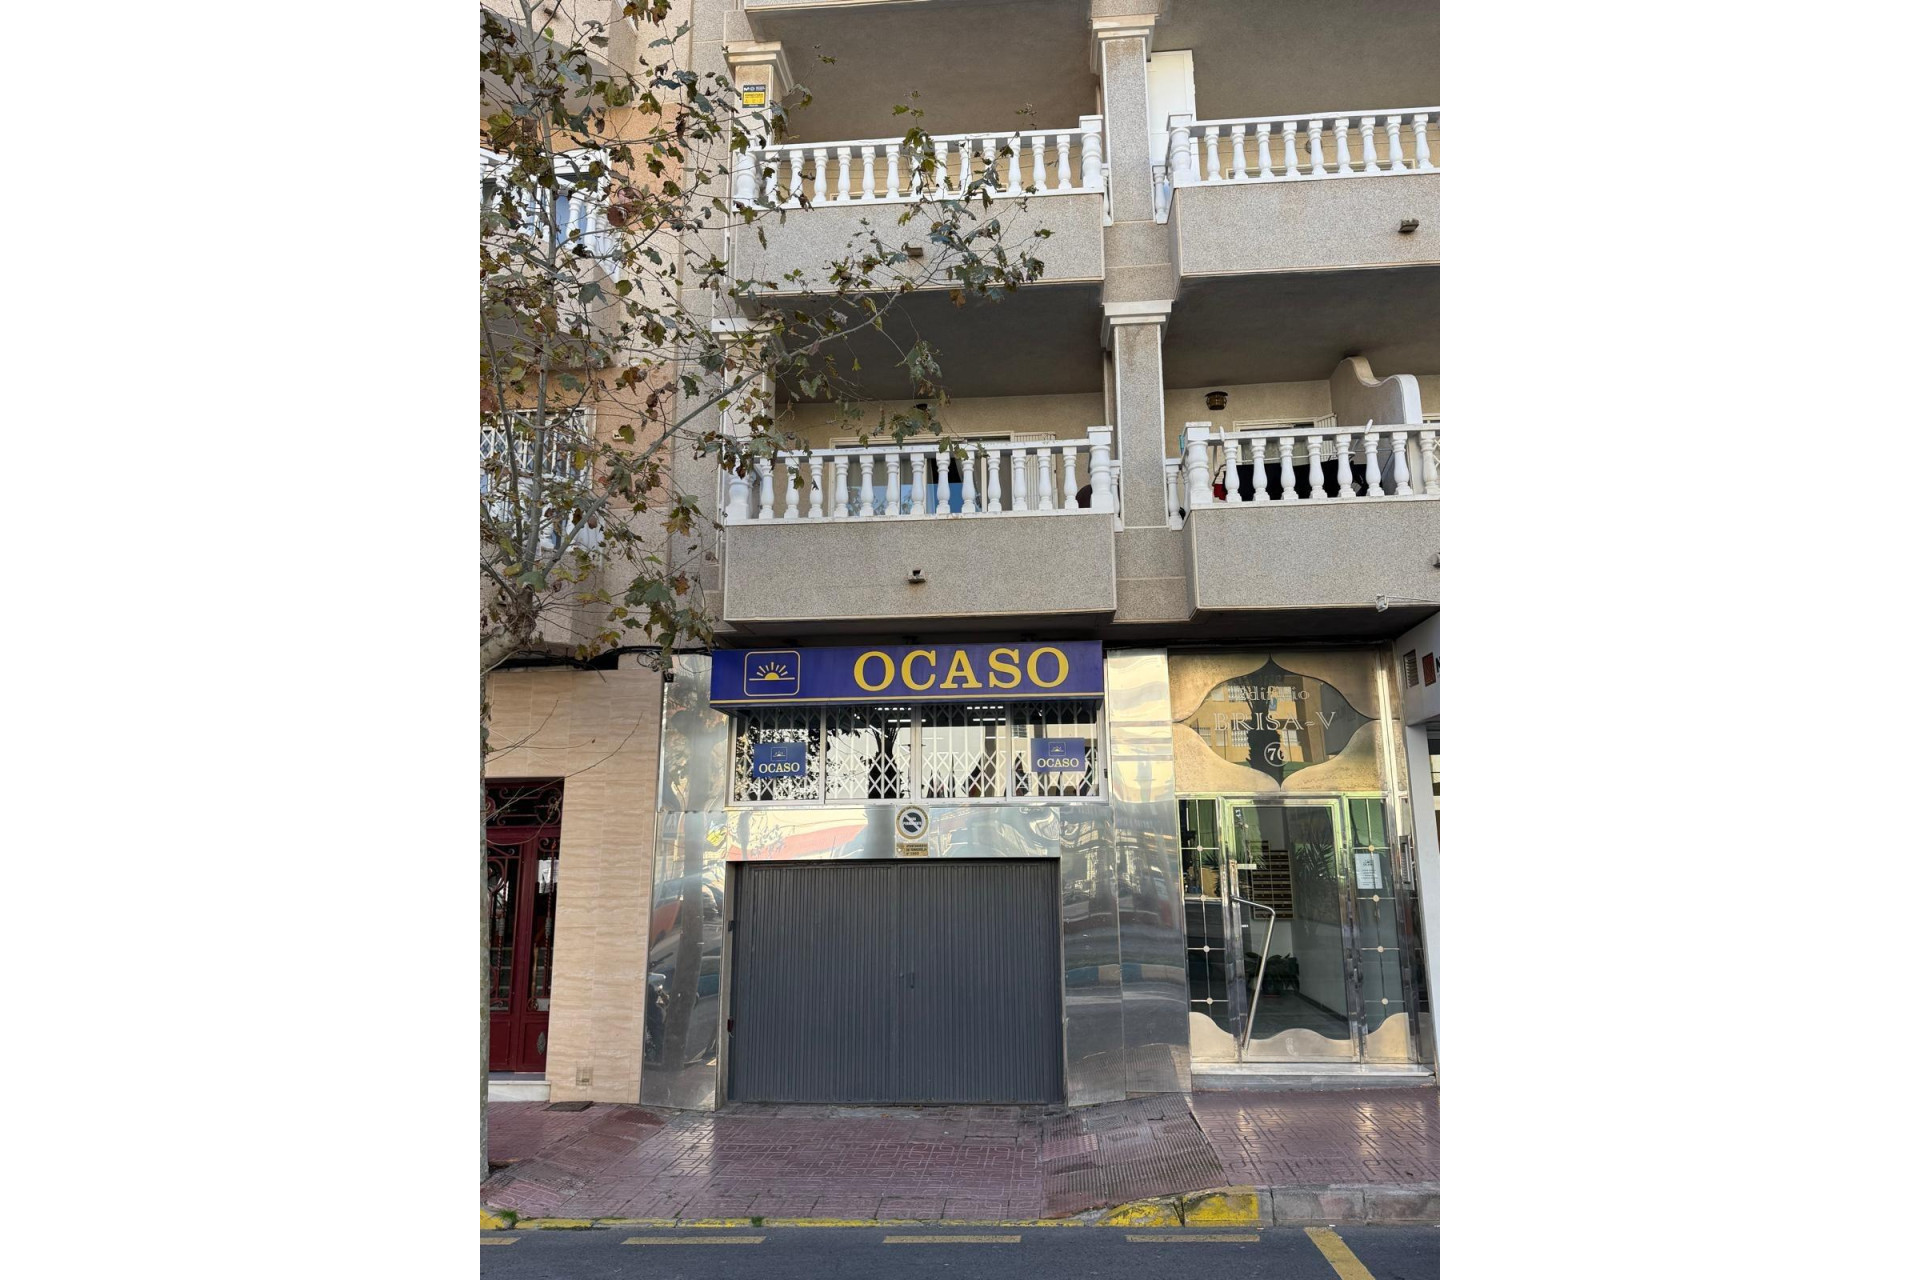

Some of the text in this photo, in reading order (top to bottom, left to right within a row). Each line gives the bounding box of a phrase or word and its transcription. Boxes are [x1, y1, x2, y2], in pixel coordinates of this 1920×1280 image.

[853, 646, 1070, 692] OCASO
[758, 762, 801, 774] OCASO
[1036, 757, 1080, 768] OCASO
